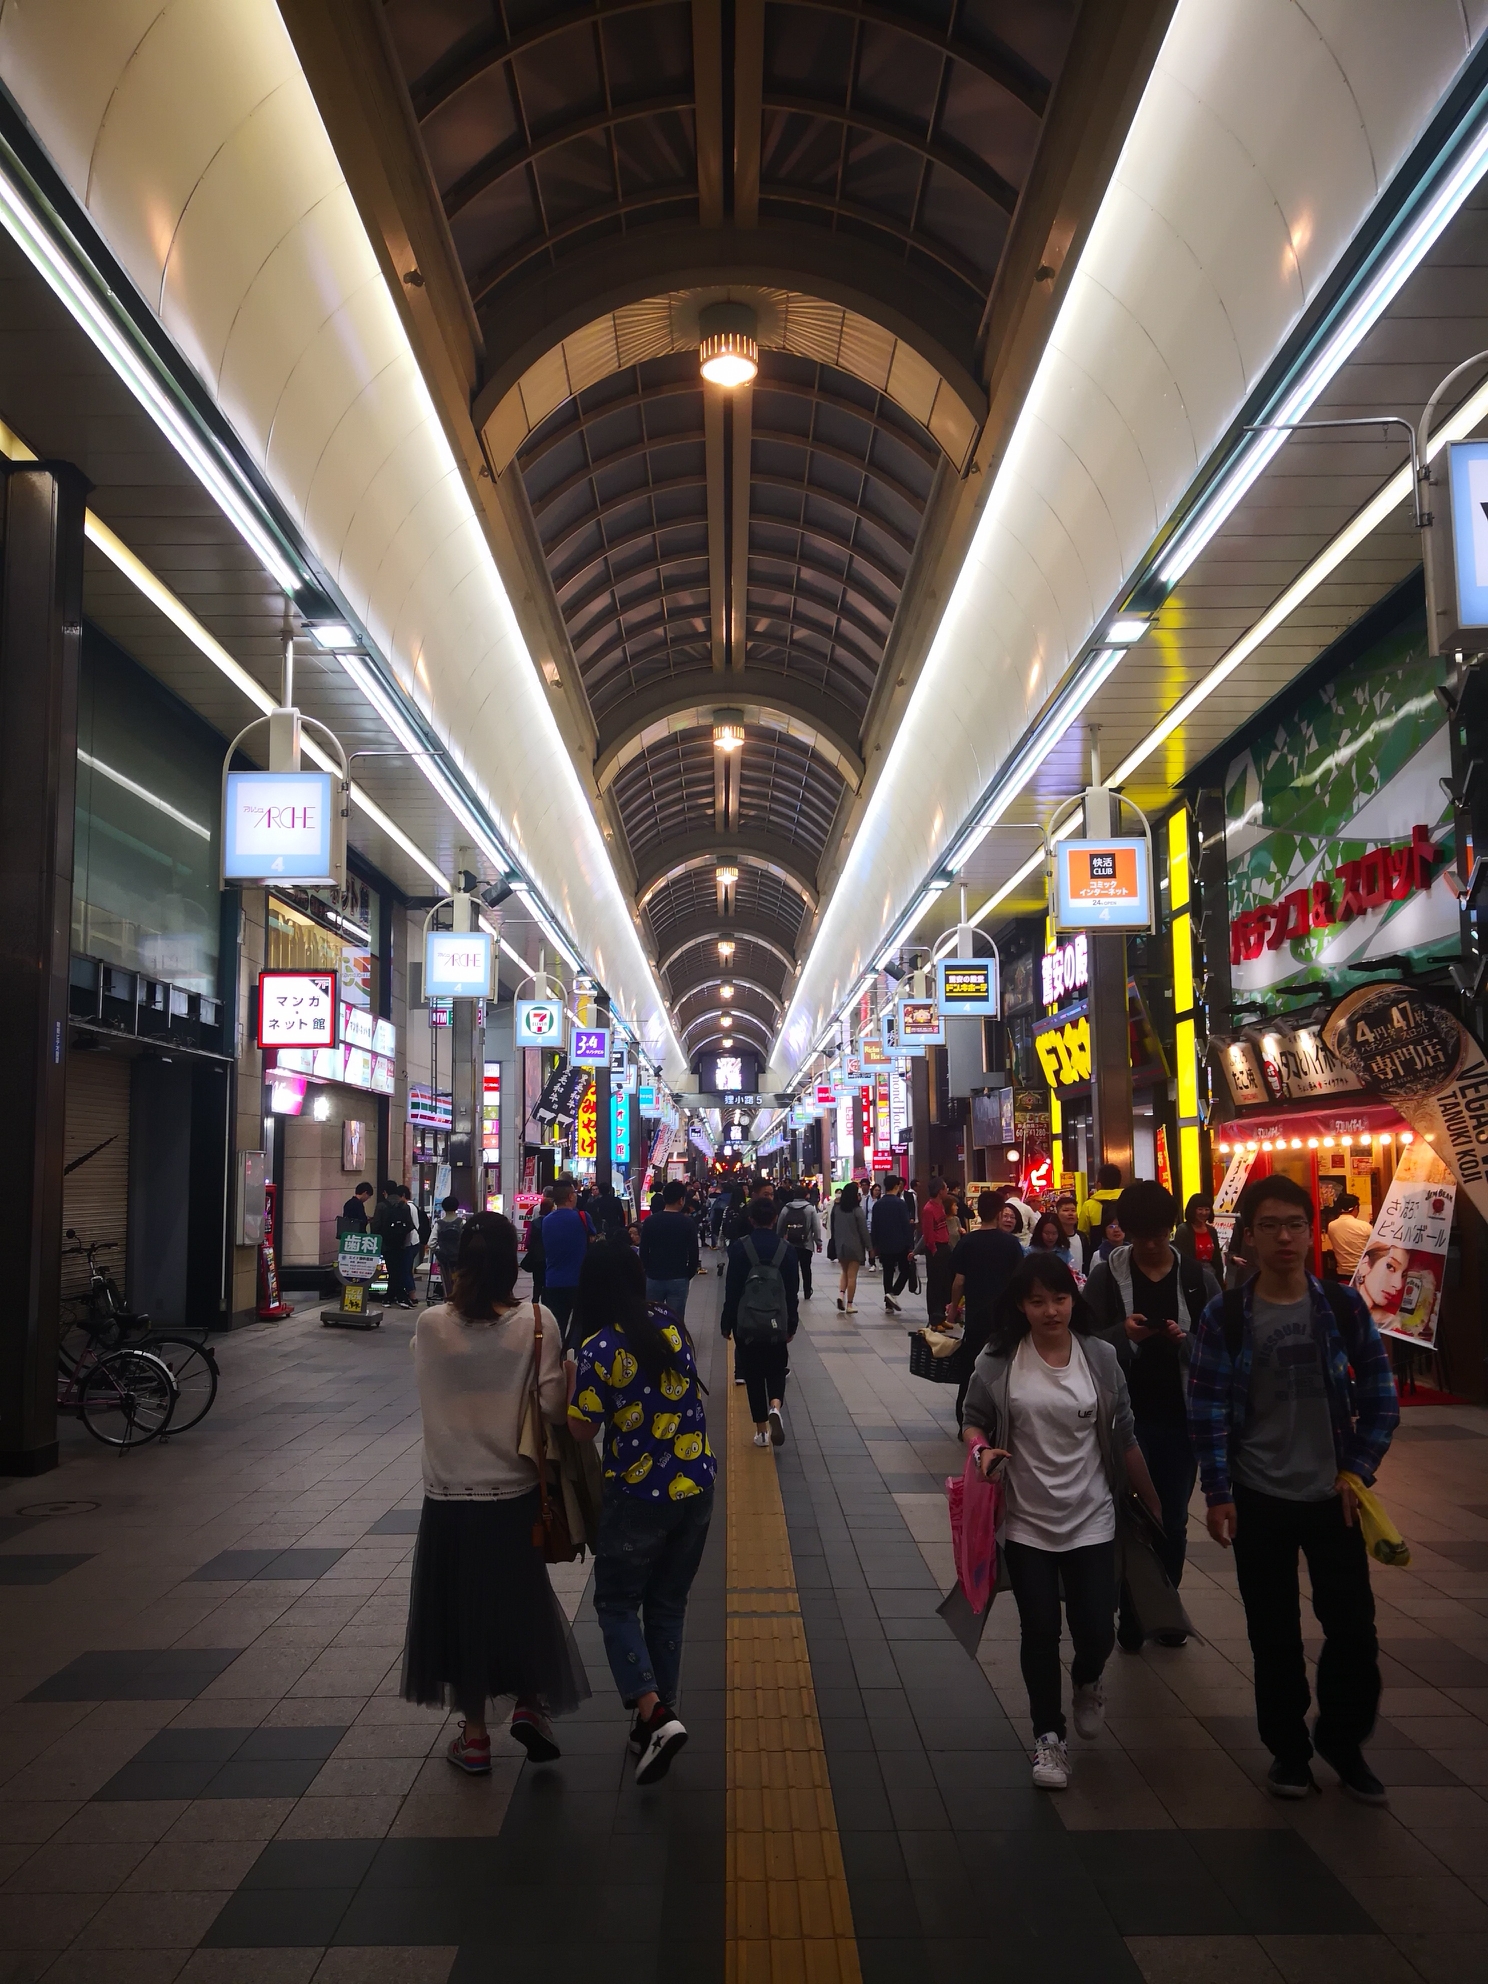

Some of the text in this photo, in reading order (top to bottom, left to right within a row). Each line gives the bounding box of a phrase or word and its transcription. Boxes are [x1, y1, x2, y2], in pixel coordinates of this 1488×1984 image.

[254, 806, 316, 829] ARCHE
[271, 857, 285, 872] 4
[1093, 857, 1113, 867] 快活
[1090, 881, 1117, 889] コミック
[1080, 888, 1128, 897] インターネット
[1099, 908, 1110, 921] 4
[444, 953, 482, 967] ARCHE
[454, 983, 463, 992] 4
[276, 995, 320, 1007] マンガ
[963, 1003, 971, 1012] 4
[1391, 1001, 1429, 1031] 47枚
[268, 1017, 325, 1030] ネット館
[1353, 1020, 1387, 1042] 4円
[1367, 1039, 1445, 1080] 専門店
[756, 1095, 763, 1105] 5
[1437, 1090, 1483, 1185] TANUKI KOJI
[344, 1234, 378, 1254] 歯科
